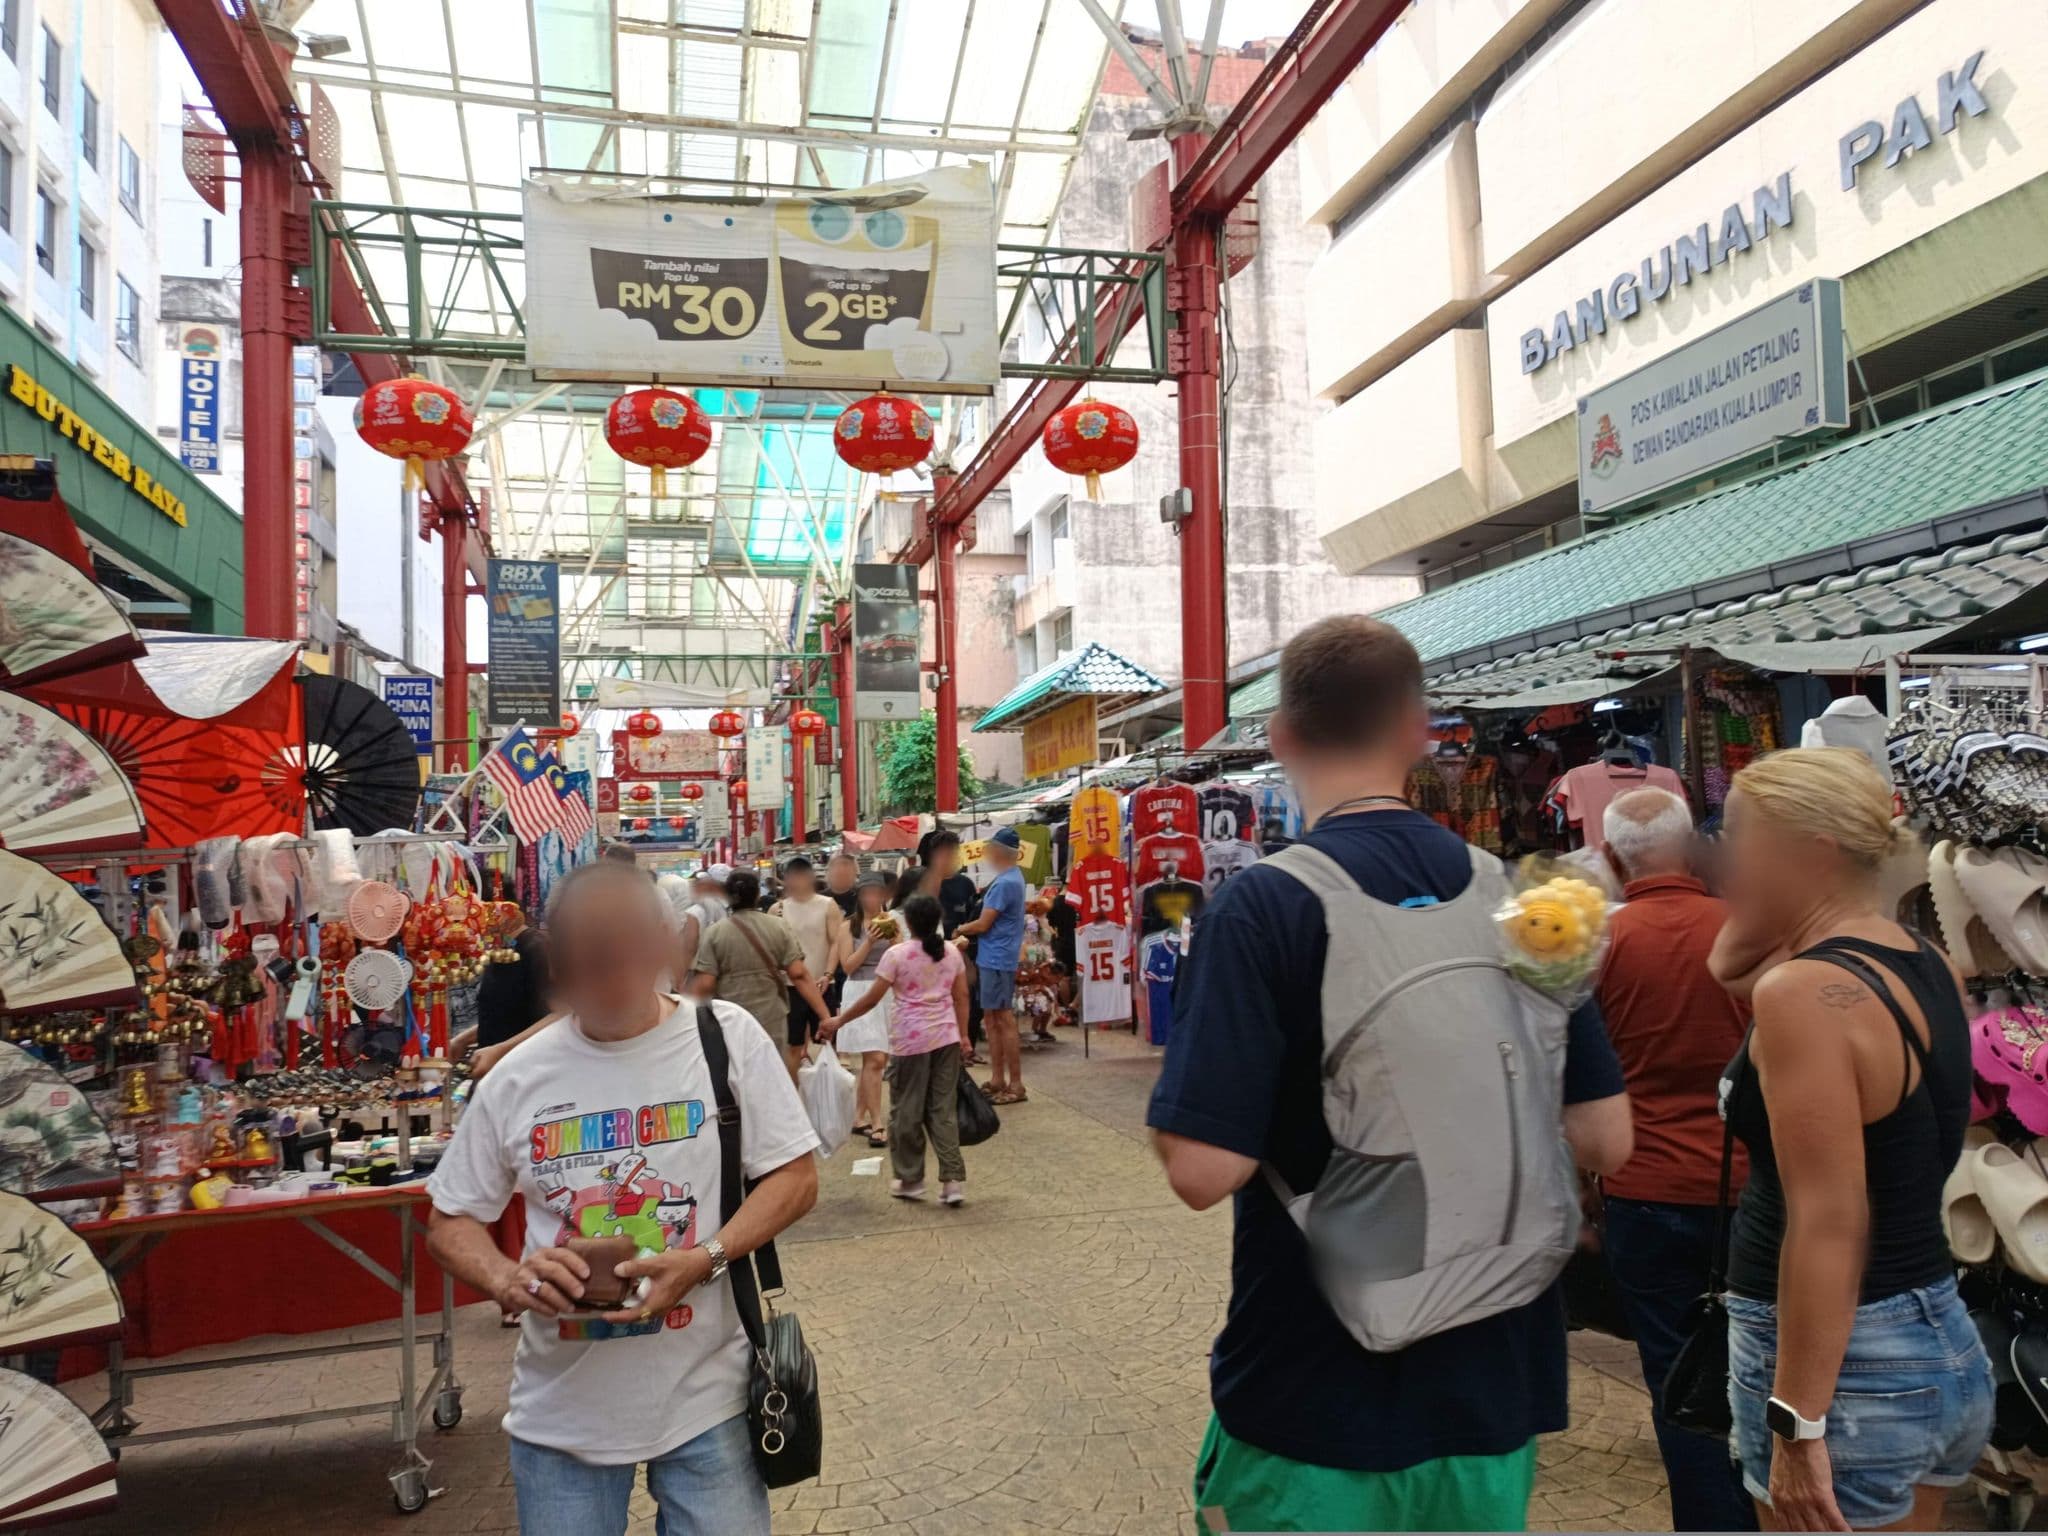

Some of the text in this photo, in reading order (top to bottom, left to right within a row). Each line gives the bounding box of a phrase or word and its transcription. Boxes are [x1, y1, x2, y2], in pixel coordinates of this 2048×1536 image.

[1520, 50, 1988, 375] BANGUNAN PAK
[644, 259, 720, 273] Tambah nilai
[664, 273, 699, 282] Top Up
[827, 281, 872, 291] Get up to
[1631, 328, 1800, 427] POS KAWALAN JALAN PETALING
[188, 360, 214, 442] HOTEL
[1632, 371, 1803, 464] DEWAN BANDARAYA KUALA LUMPUR
[9, 363, 188, 528] BUTTER KAYA
[498, 583, 547, 591] MALAYSIA
[500, 564, 547, 583] BBX
[386, 682, 431, 696] HOTEL
[386, 699, 431, 713] CHINA
[1086, 816, 1111, 844] 15
[1203, 809, 1237, 841] 10
[1088, 883, 1115, 914] 15
[1090, 951, 1114, 981] 15
[530, 1100, 705, 1163] SUMMER CAMP
[531, 1160, 563, 1177] TRACK
[574, 1154, 605, 1168] FIELD
